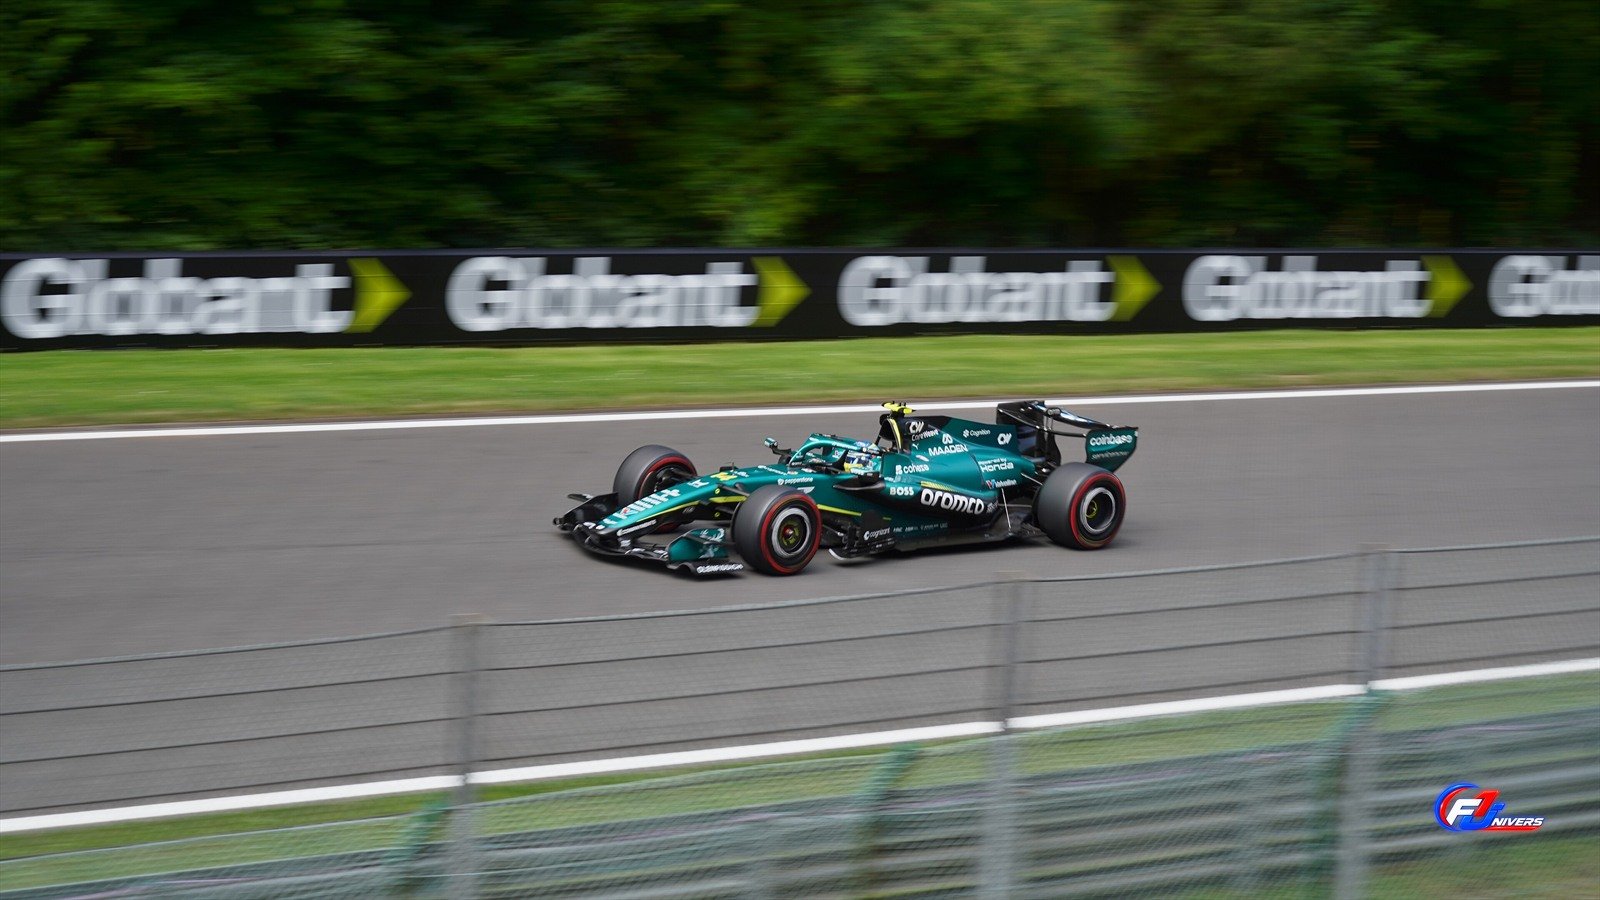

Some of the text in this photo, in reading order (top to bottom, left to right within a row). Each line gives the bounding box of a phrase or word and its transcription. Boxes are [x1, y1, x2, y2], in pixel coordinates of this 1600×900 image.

[1, 257, 354, 339] Globant
[446, 256, 758, 331] Globant
[837, 256, 1116, 326] Globant
[1182, 255, 1432, 321] Globant
[928, 444, 969, 457] MAADEN
[1089, 433, 1133, 446] coinbase
[980, 462, 1015, 473] Honda
[890, 487, 915, 496] BOSS
[920, 488, 985, 515] aramco
